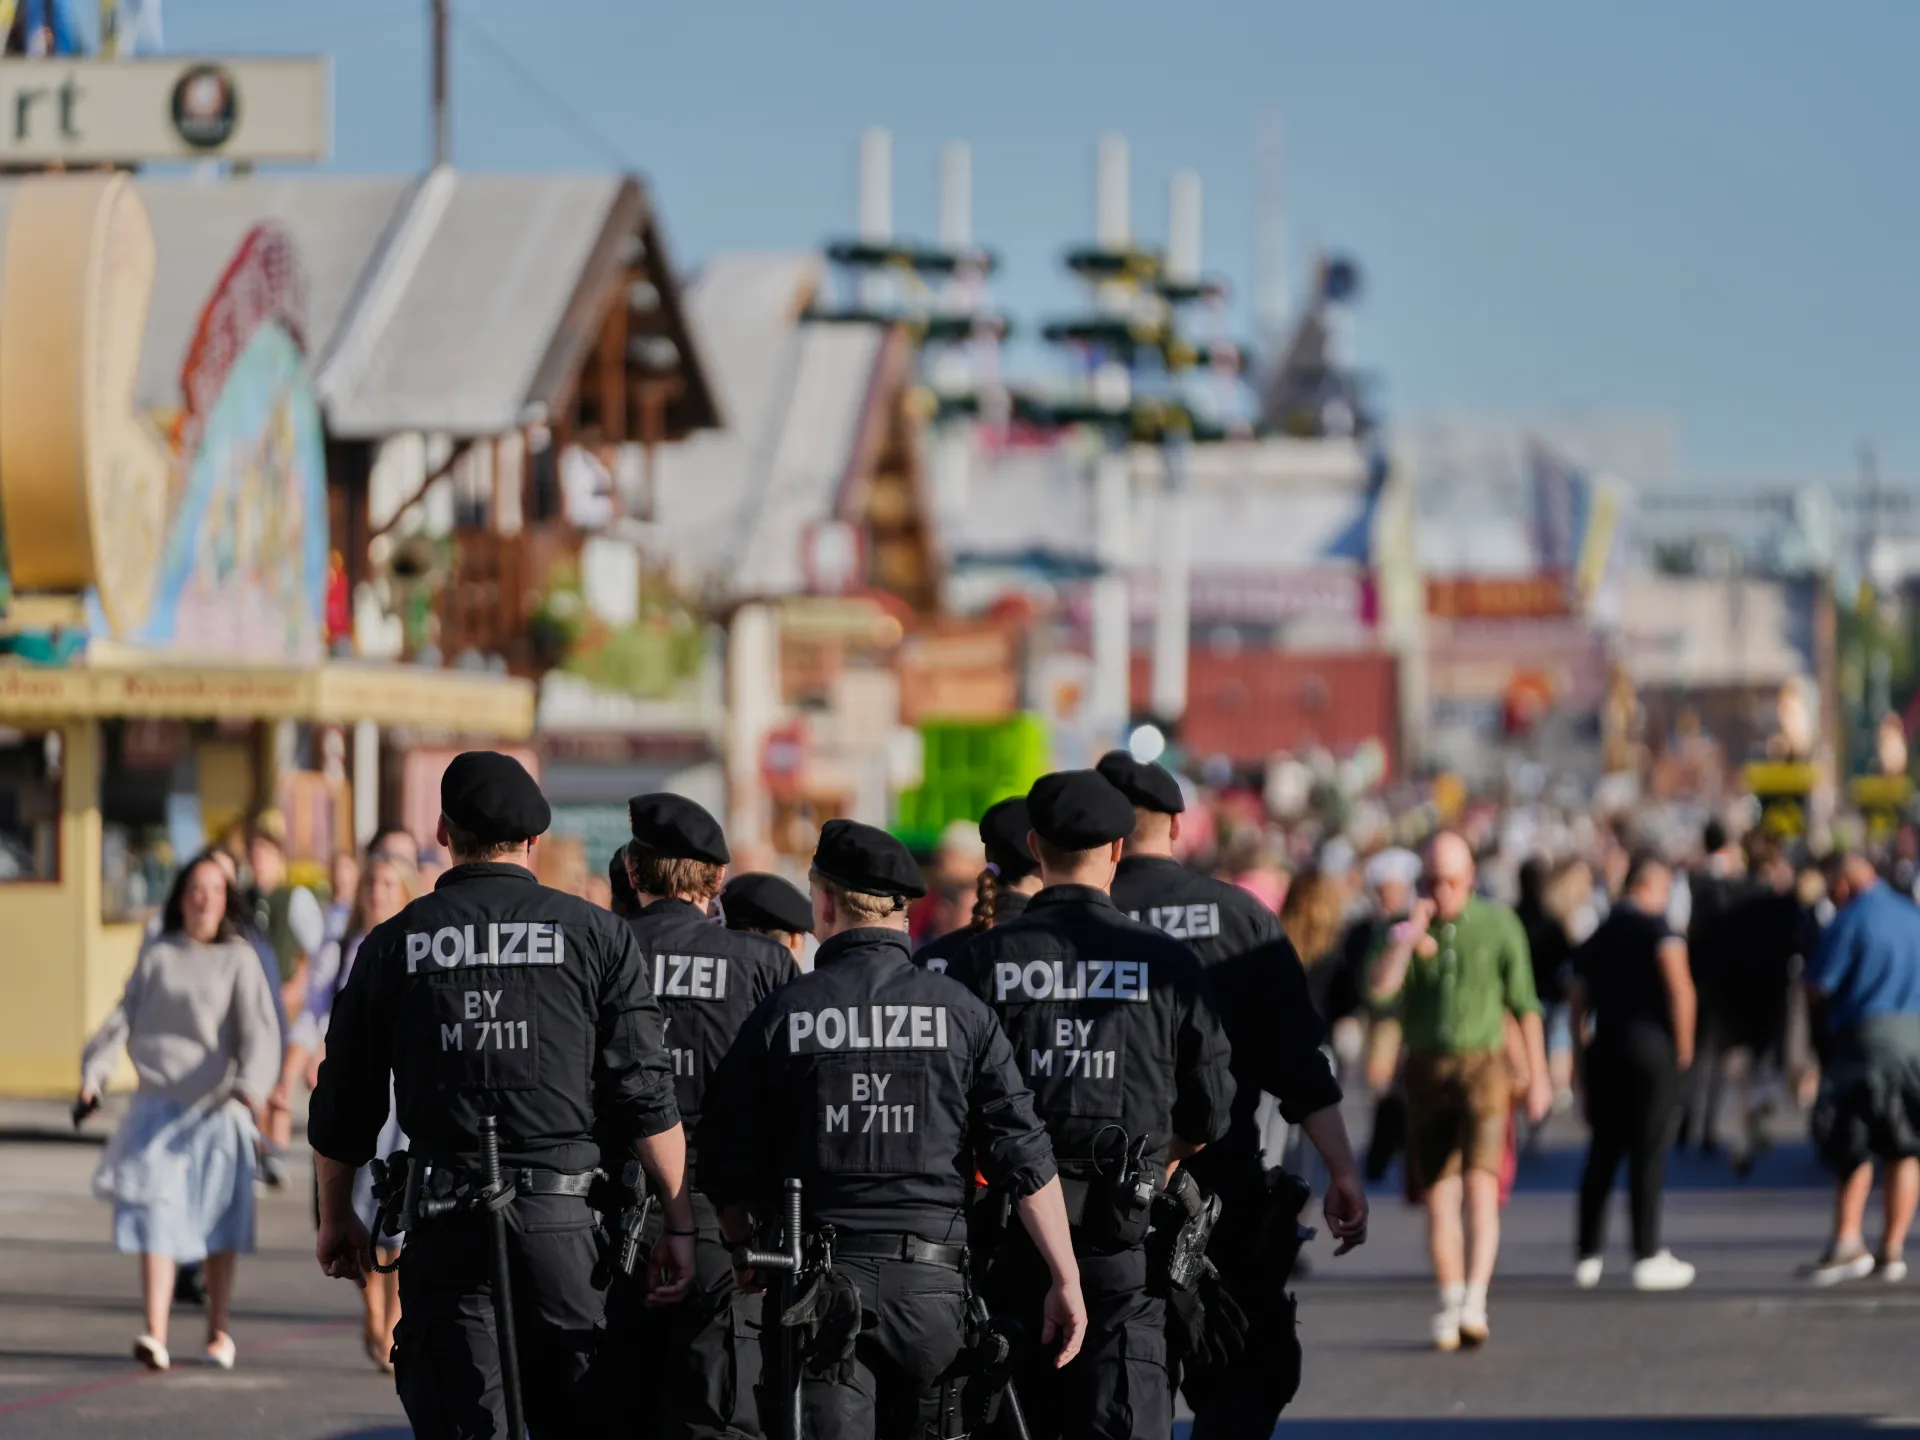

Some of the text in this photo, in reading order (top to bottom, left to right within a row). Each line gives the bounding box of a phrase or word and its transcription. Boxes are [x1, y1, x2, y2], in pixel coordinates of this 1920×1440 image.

[406, 922, 565, 973] POLIZEI
[654, 954, 727, 998] IZEI
[996, 960, 1149, 1001] POLIZEI
[464, 990, 503, 1019] BY
[441, 1020, 528, 1051] M 7111
[789, 1005, 948, 1053] POLIZEI
[1056, 1018, 1094, 1047] BY
[1030, 1048, 1116, 1078] M 7111
[852, 1073, 892, 1102] BY
[826, 1104, 914, 1133] M 7111
